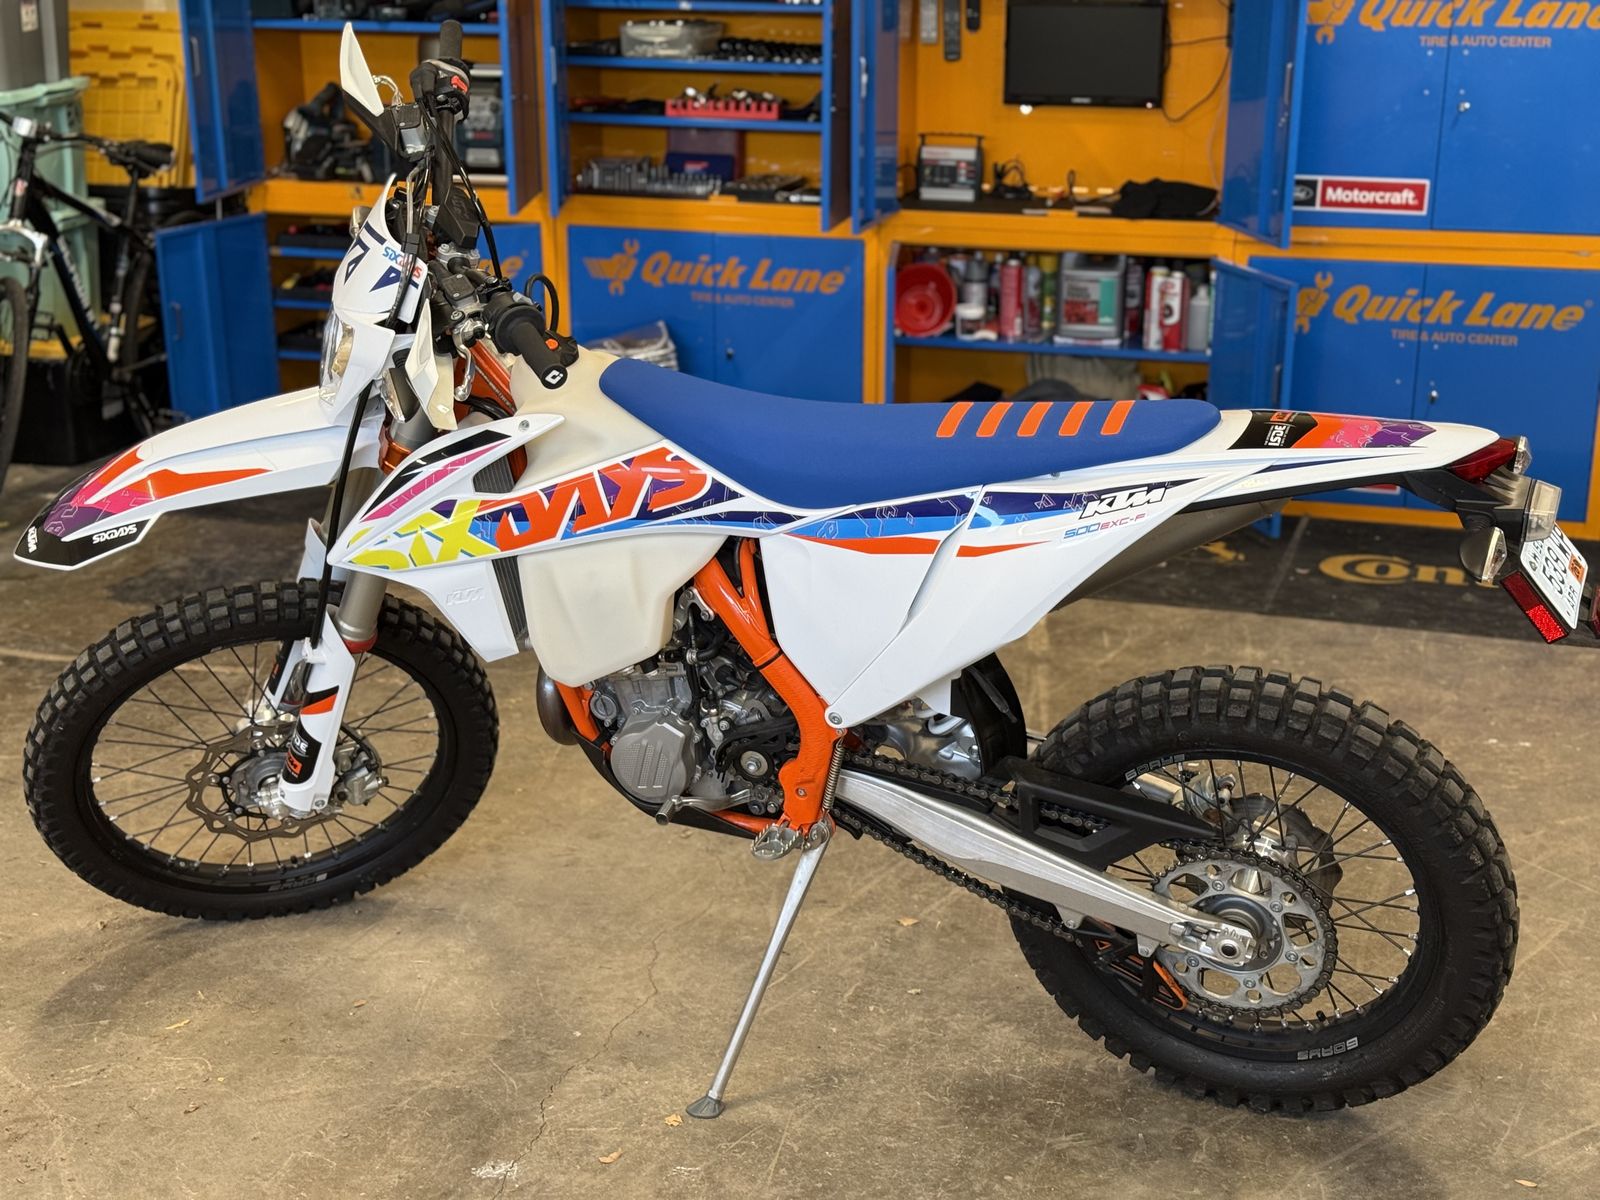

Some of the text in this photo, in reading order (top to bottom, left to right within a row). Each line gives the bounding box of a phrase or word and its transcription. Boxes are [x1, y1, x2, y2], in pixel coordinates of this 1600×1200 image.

[1358, 0, 1491, 31] Quick
[1419, 35, 1552, 48] TIRE & AUTO CENTER
[641, 252, 845, 294] Quick Lane
[1332, 284, 1585, 331] Quick Lane
[1391, 328, 1518, 346] TIRE & AUTO CENTER
[1079, 486, 1167, 520] KTM
[27, 525, 38, 554] KTM
